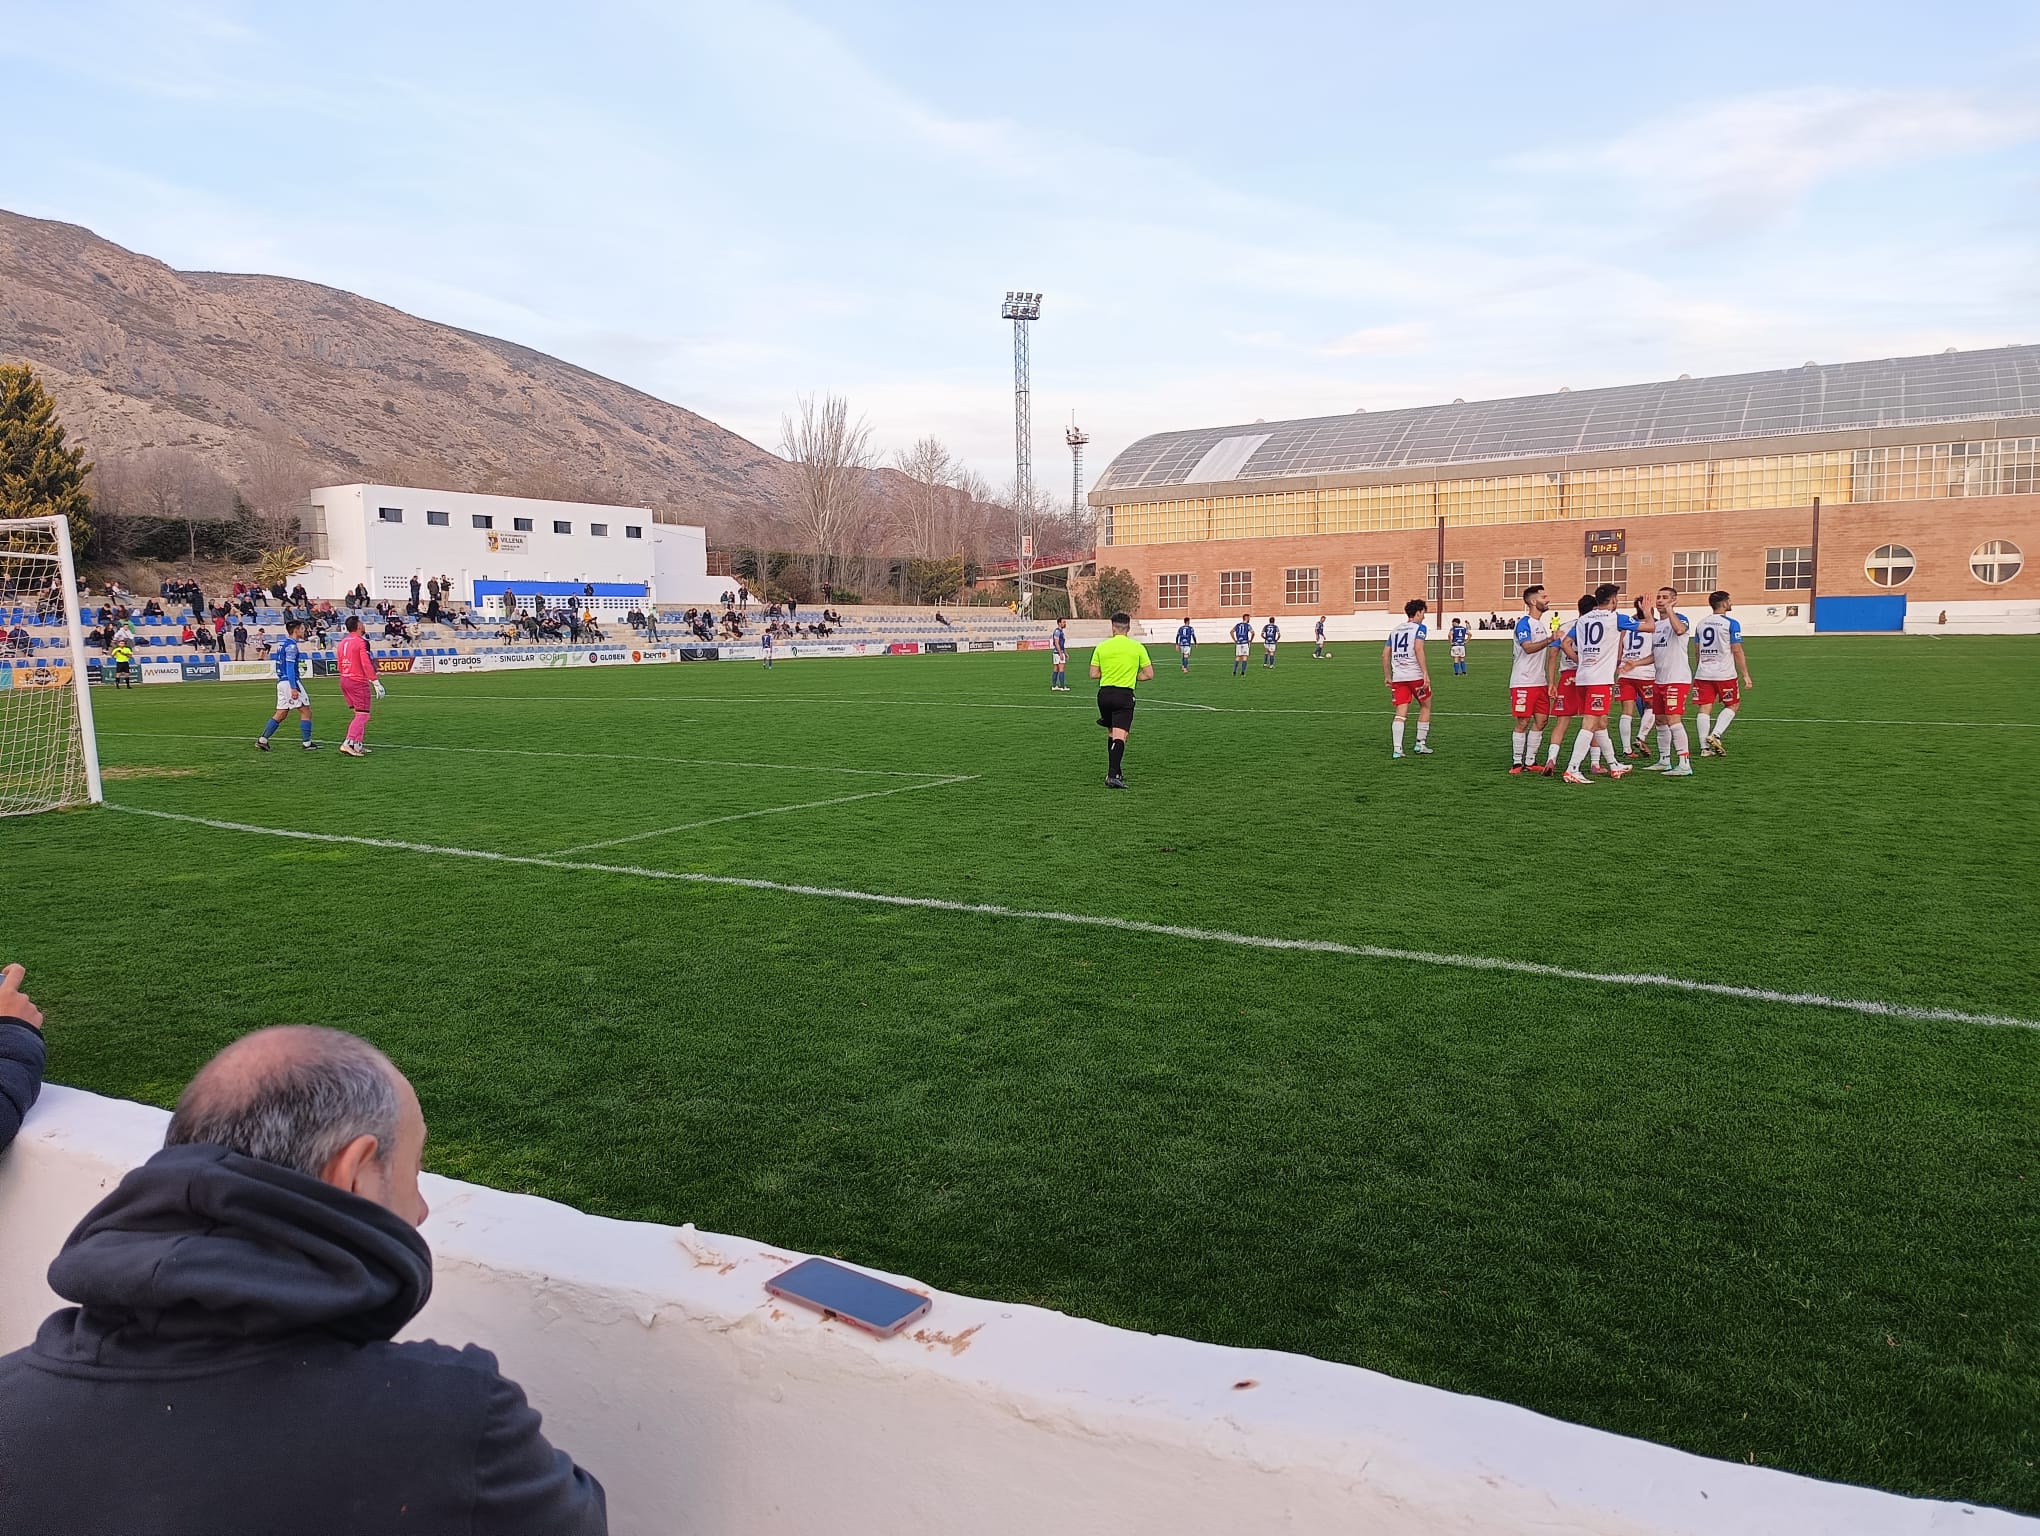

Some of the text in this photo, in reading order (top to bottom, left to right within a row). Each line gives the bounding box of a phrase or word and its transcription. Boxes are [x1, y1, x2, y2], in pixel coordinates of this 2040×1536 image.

[1393, 632, 1409, 653] 14
[1584, 621, 1604, 646] 10
[1627, 630, 1645, 651] 15
[1703, 627, 1715, 648] 9
[379, 661, 410, 671] SABOY
[452, 656, 482, 667] grados
[499, 654, 535, 663] SINGULAR
